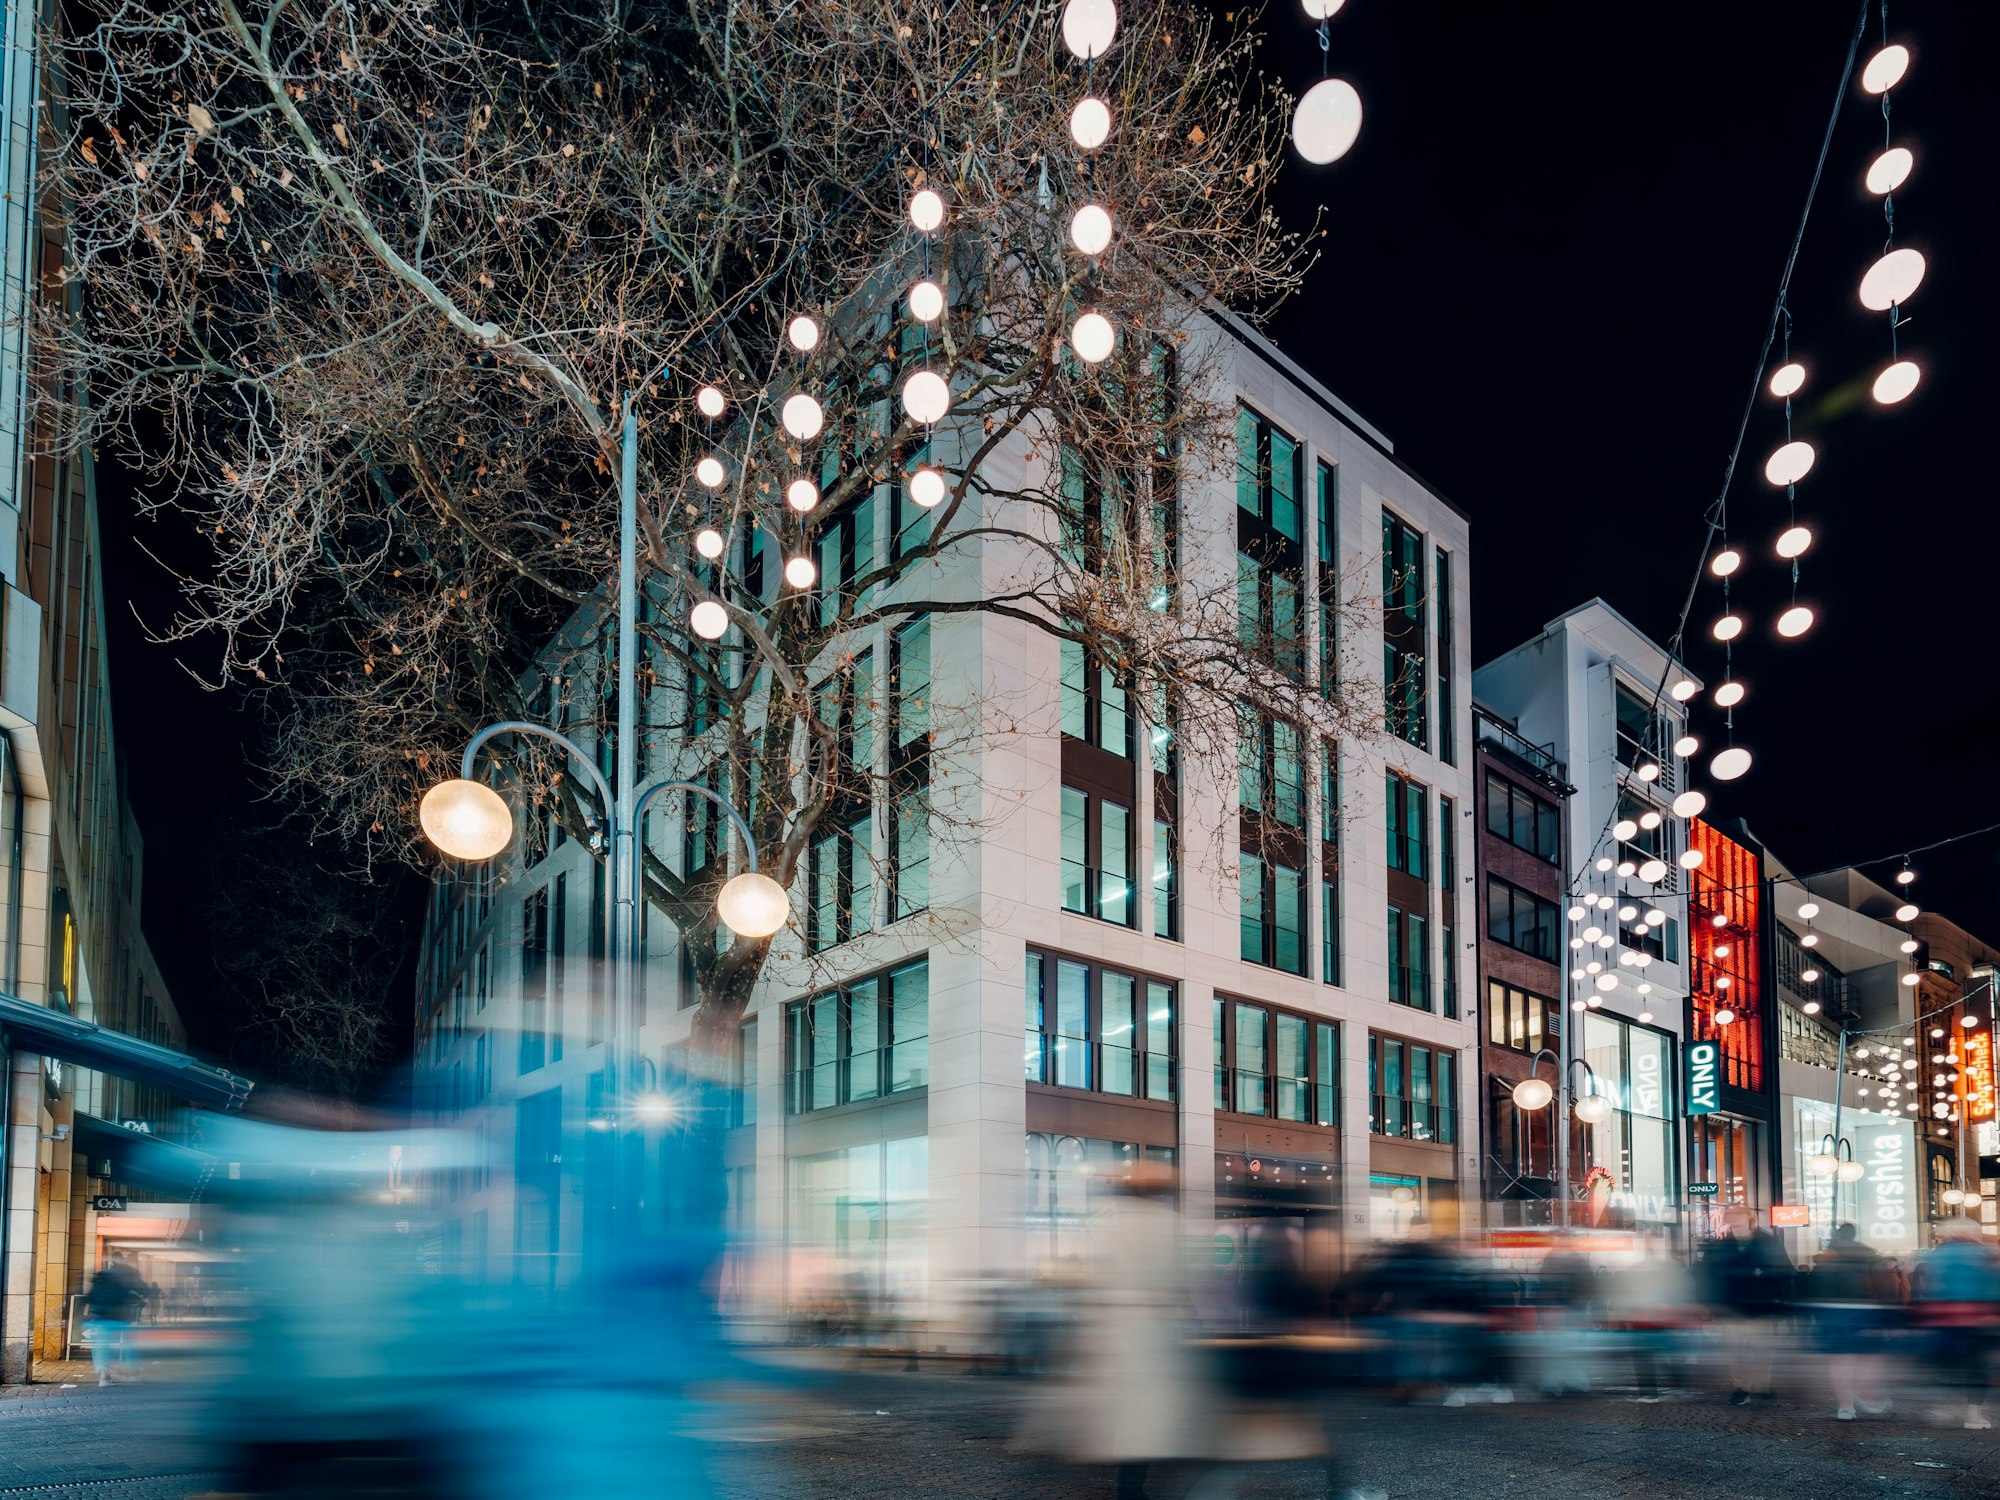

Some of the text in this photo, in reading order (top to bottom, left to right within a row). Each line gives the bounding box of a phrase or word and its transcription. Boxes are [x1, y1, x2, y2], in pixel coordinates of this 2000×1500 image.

[1691, 1044, 1714, 1108] ONLY
[1971, 1032, 1990, 1115] SportScheck
[123, 1120, 150, 1133] C&A
[97, 1197, 122, 1209] C&A
[1689, 1185, 1717, 1193] ONLY
[1867, 1134, 1906, 1239] Bershka
